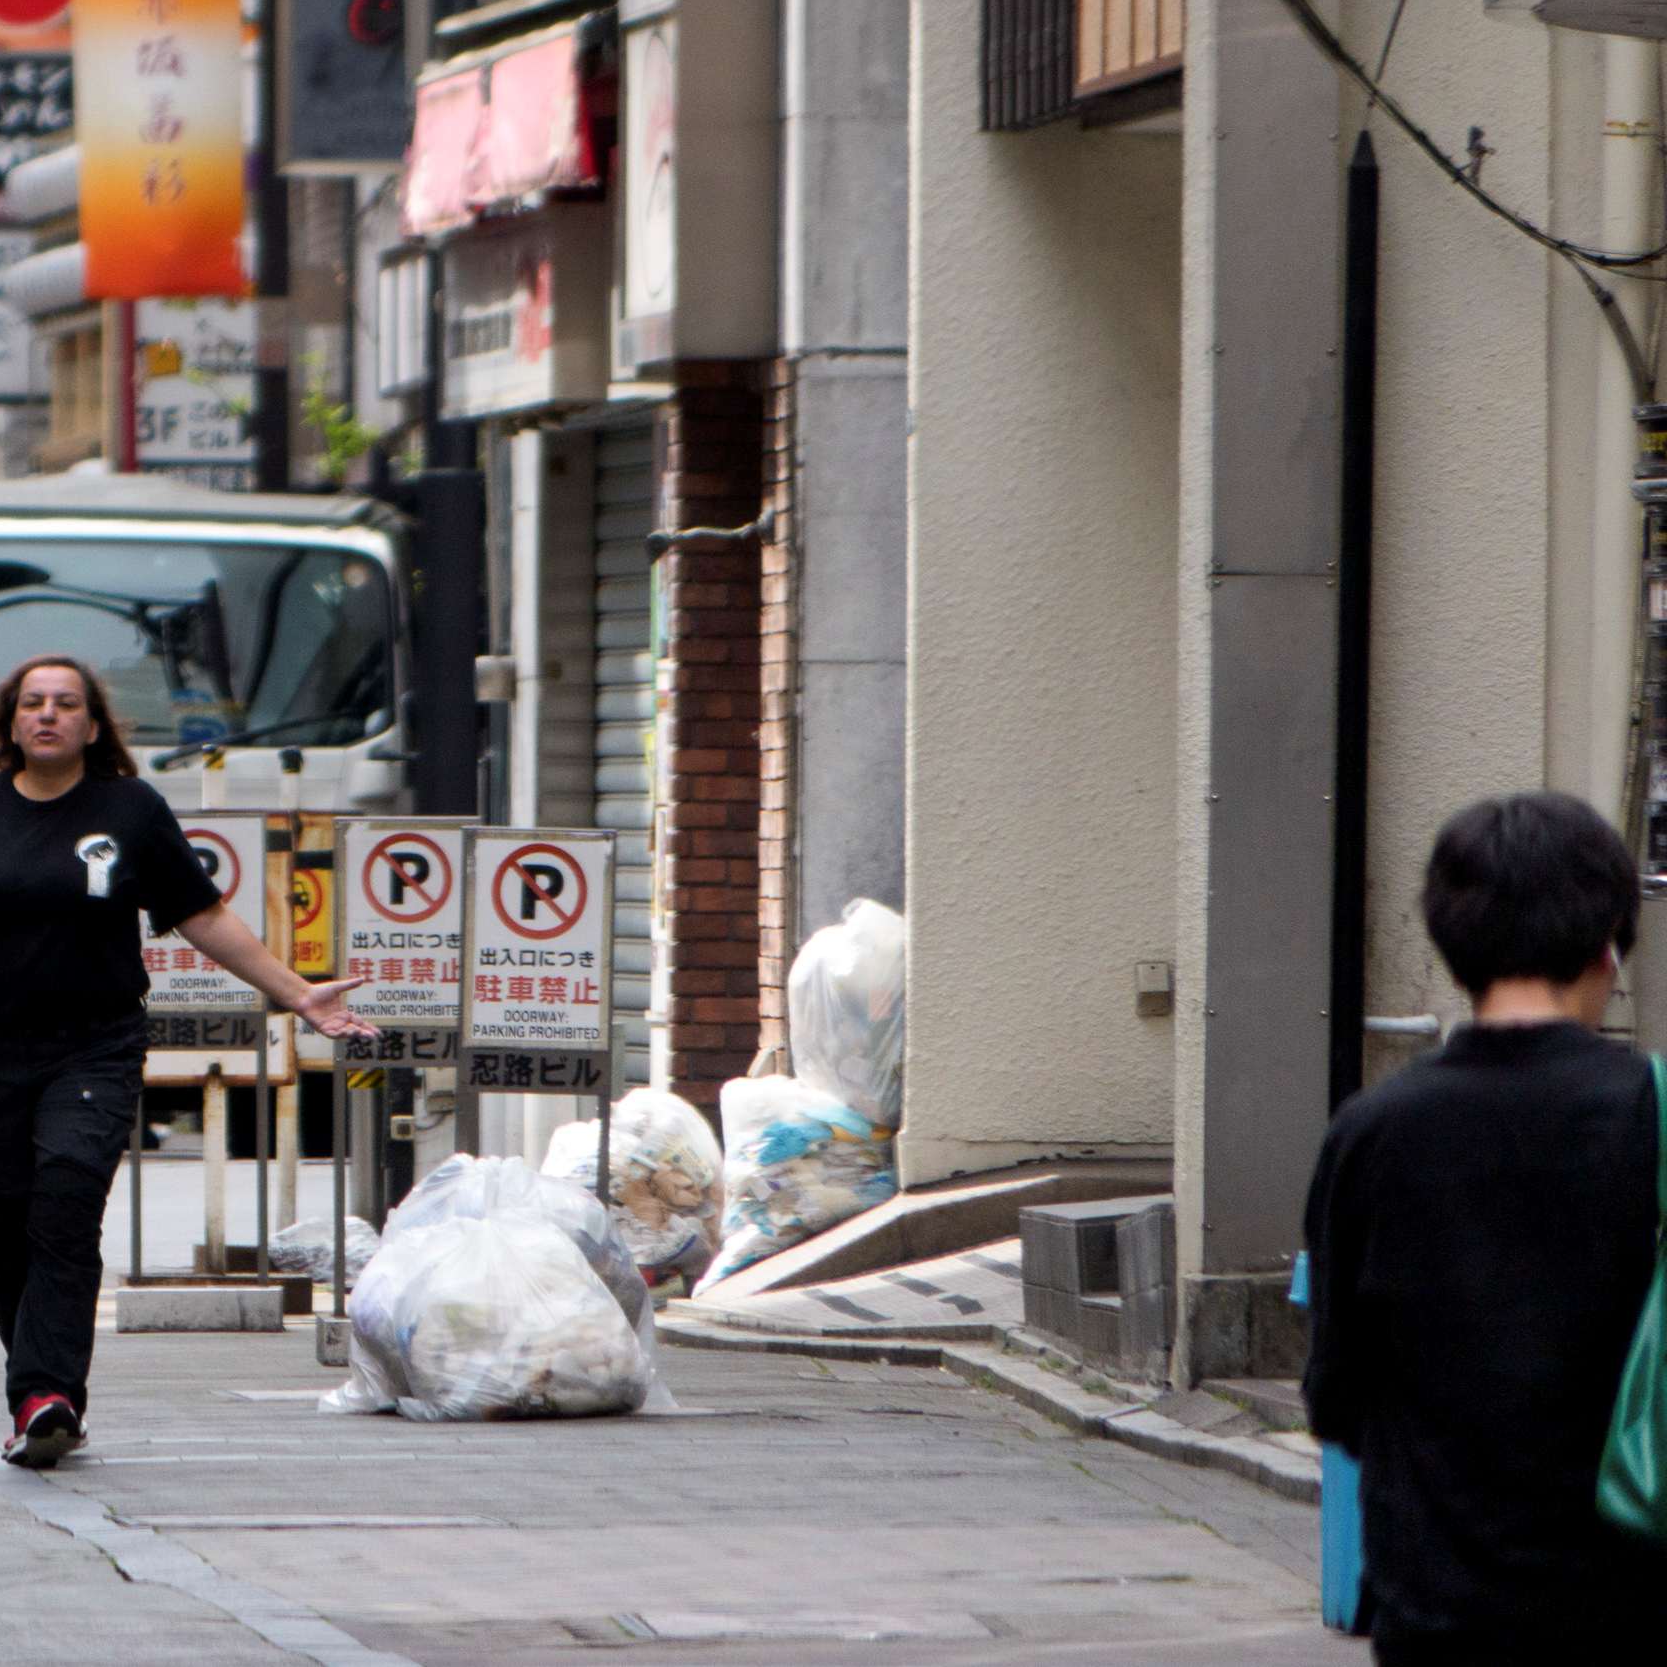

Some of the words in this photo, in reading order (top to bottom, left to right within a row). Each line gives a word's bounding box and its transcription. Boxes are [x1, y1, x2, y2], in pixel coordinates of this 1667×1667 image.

[478, 947, 595, 968] 出入口につき
[474, 974, 601, 1006] 駐車禁止
[399, 1005, 461, 1016] PROHIBITE
[504, 1010, 569, 1024] DOORWAY:
[473, 1024, 525, 1038] PARKING
[528, 1026, 601, 1040] PROHIBITED
[470, 1052, 602, 1088] 忍路ビル
